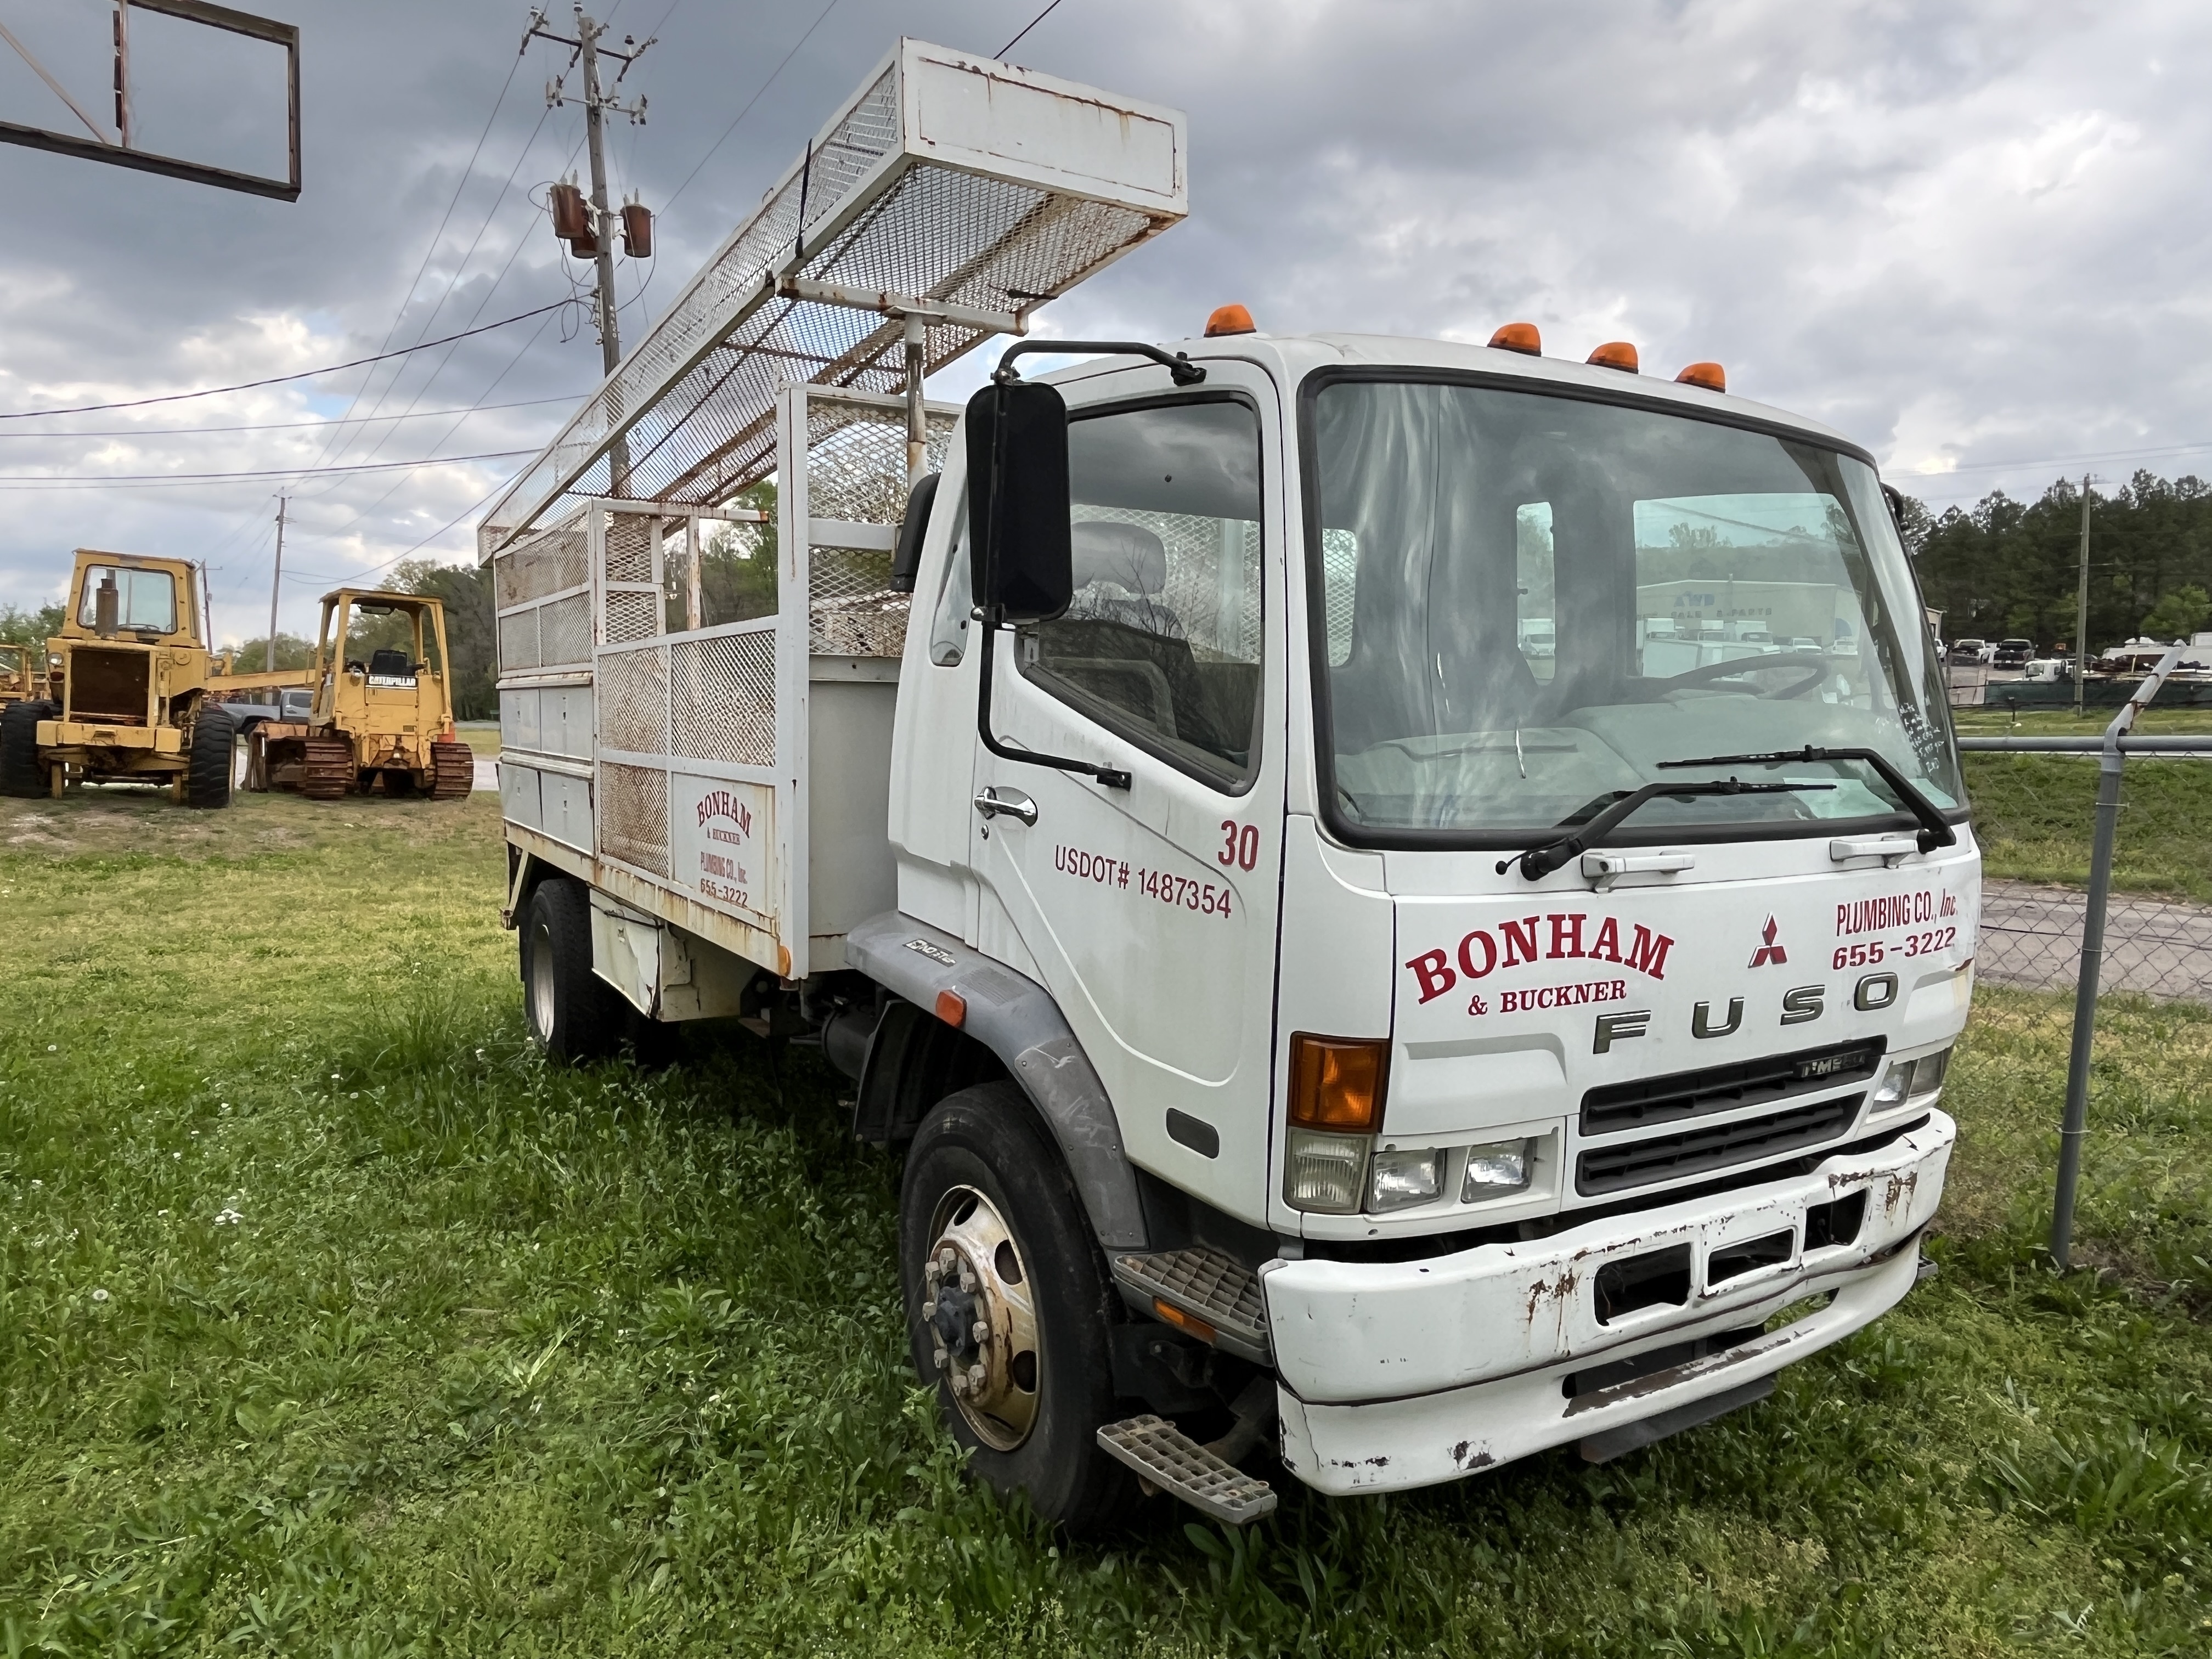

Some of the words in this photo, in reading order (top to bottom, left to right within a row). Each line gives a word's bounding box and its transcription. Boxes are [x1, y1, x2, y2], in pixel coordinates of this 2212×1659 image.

[697, 791, 752, 838] BONHAM
[1218, 820, 1259, 872] 30
[701, 878, 748, 907] 655-3222
[1056, 844, 1130, 890] USDOT#
[1138, 868, 1231, 918] 1487354
[1837, 894, 1910, 936] PLUMBING
[1406, 914, 1674, 1005] BONHAM
[1832, 927, 1956, 970] 655-3222
[1468, 995, 1487, 1016] &
[1500, 980, 1627, 1013] BUCKNER
[1593, 972, 1899, 1054] FUSO
